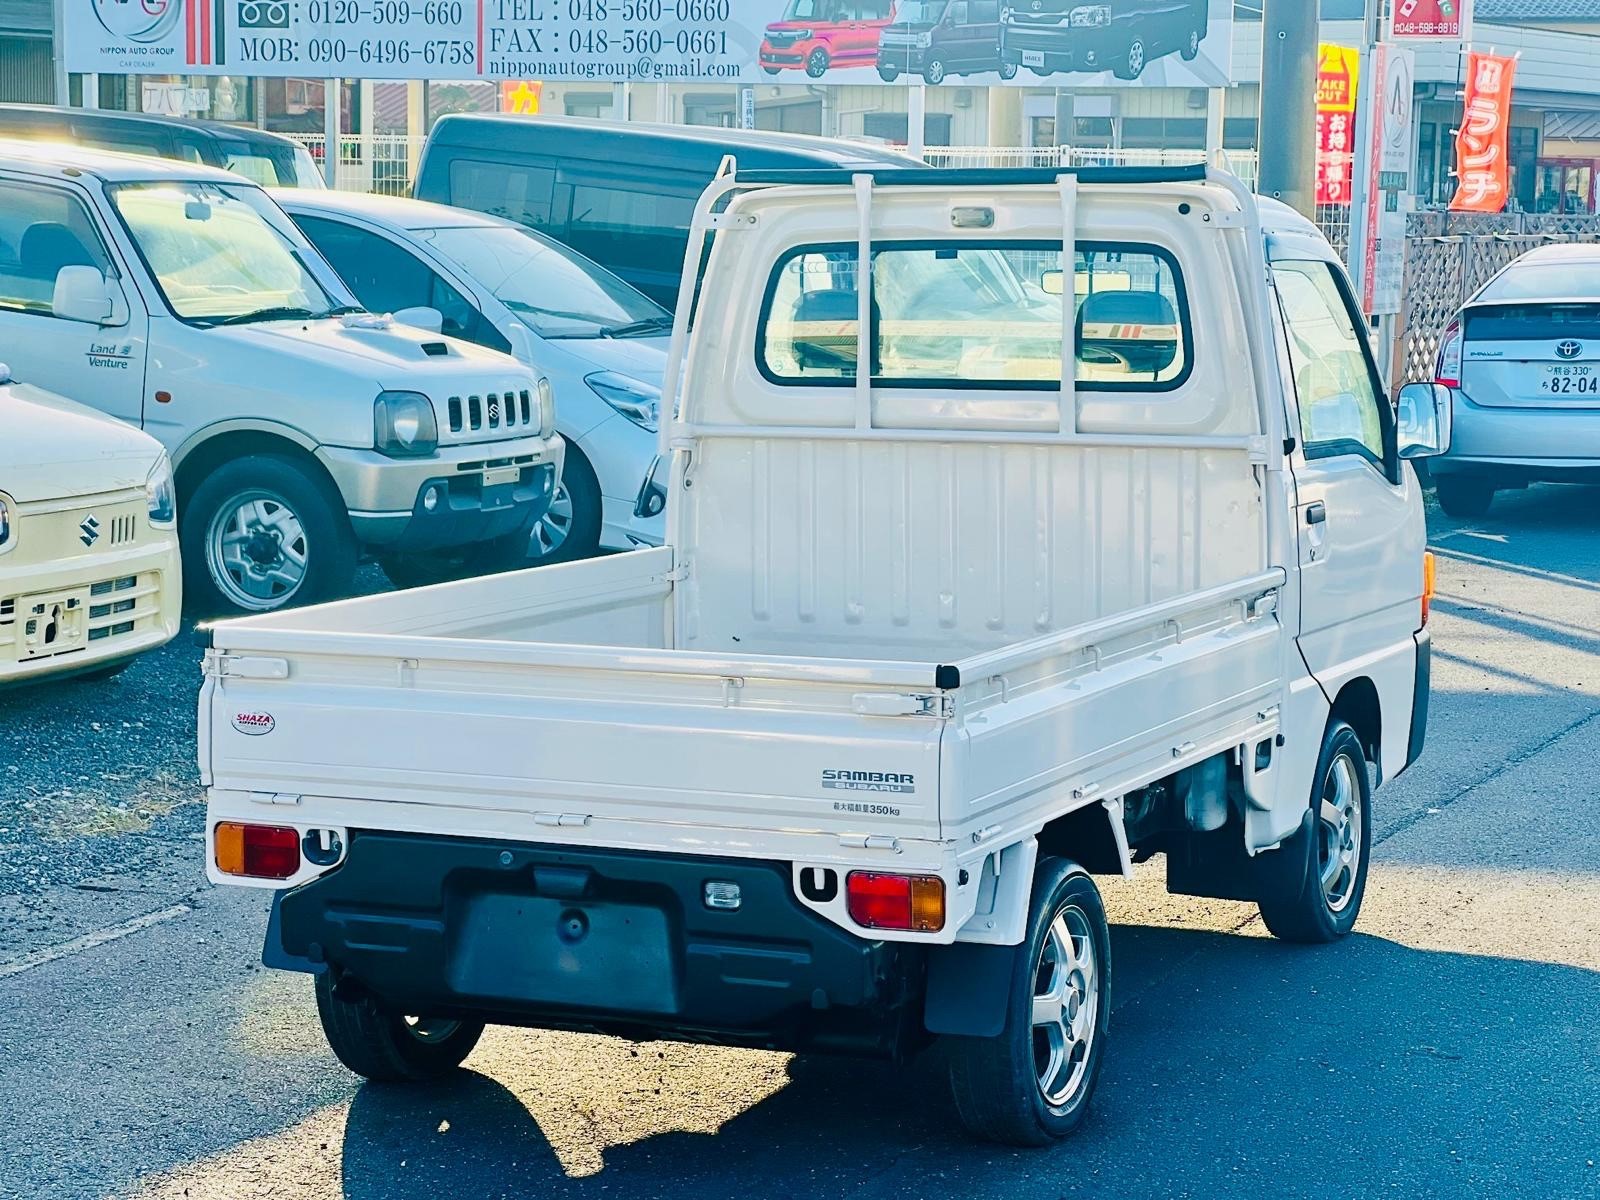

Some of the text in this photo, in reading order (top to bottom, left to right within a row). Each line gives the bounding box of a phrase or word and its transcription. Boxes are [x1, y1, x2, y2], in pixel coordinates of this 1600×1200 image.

[308, 1, 462, 25] 0120-509-660
[495, 0, 543, 21] TEL
[568, 0, 730, 21] 048-560-0660
[490, 28, 543, 52] FAX
[569, 29, 728, 54] 048-560-0661
[308, 39, 474, 64] 090-6496-6758
[489, 57, 741, 78] nipponautogroup@gmail.com
[1462, 97, 1500, 205] ランチ
[90, 343, 116, 354] Land
[89, 356, 128, 369] Venture
[1572, 366, 1589, 376] 330
[1551, 377, 1598, 394] 82-04
[237, 714, 269, 722] SHAZA
[822, 769, 914, 784] SAMBAR
[835, 782, 902, 792] SUBARU
